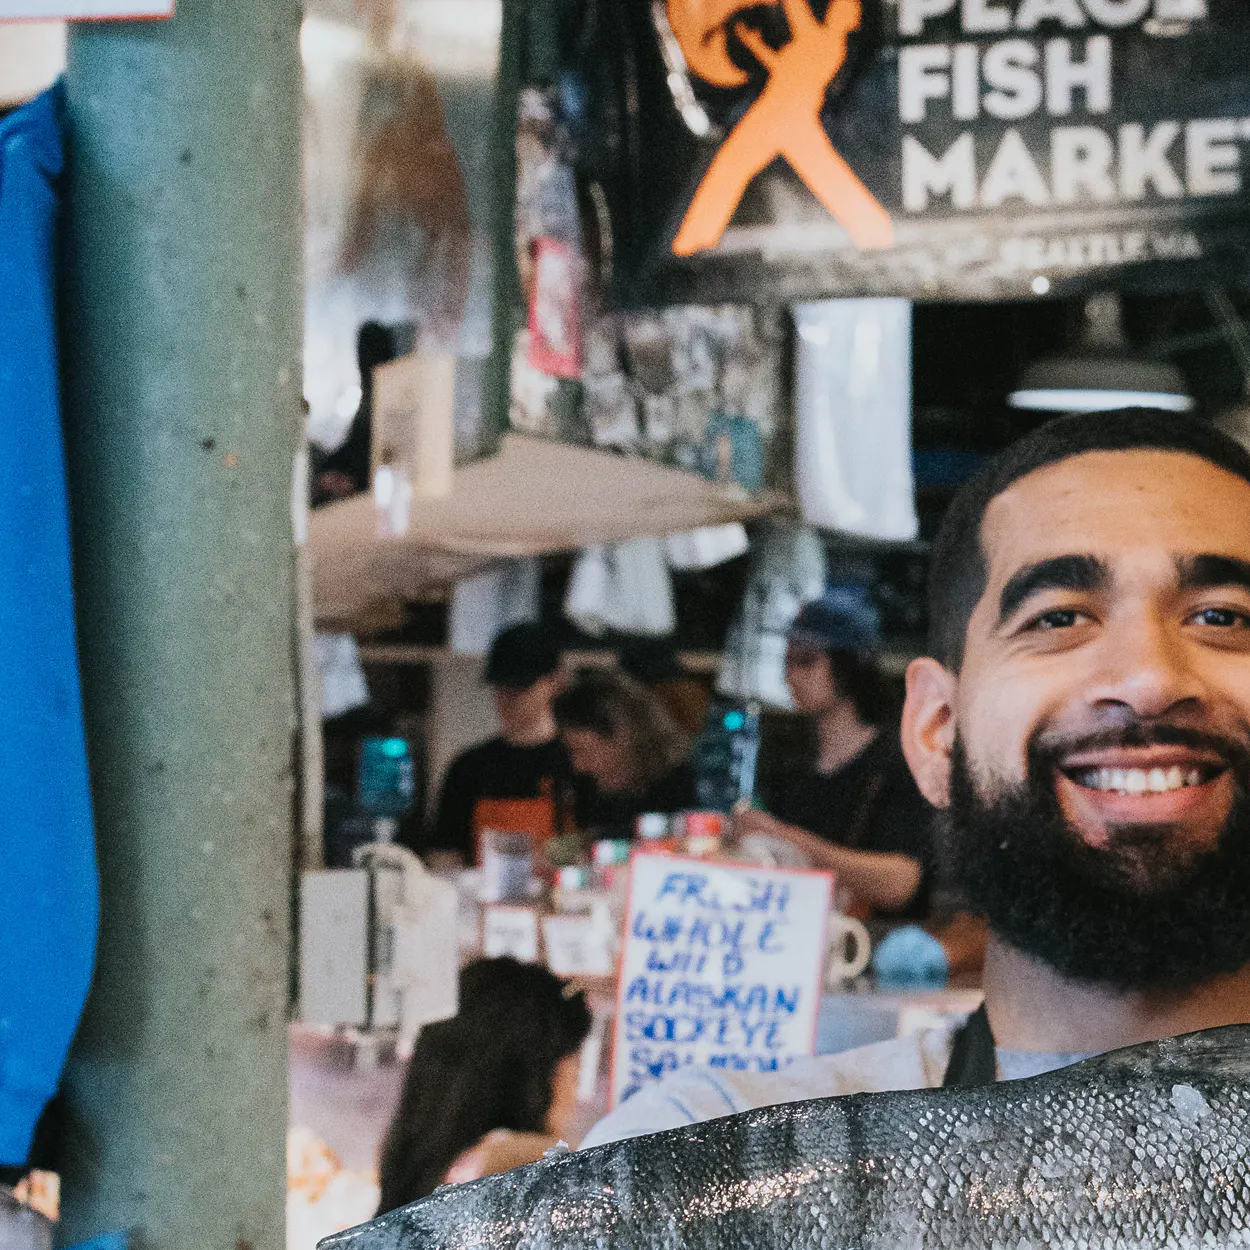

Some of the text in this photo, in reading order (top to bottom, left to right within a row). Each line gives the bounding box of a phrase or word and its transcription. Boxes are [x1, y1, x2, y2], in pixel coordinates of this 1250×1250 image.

[899, 36, 1112, 123] FISH
[632, 910, 784, 954] WHOLE
[625, 975, 800, 1015] ALASKAN
[626, 1011, 783, 1049] SOCKEYE
